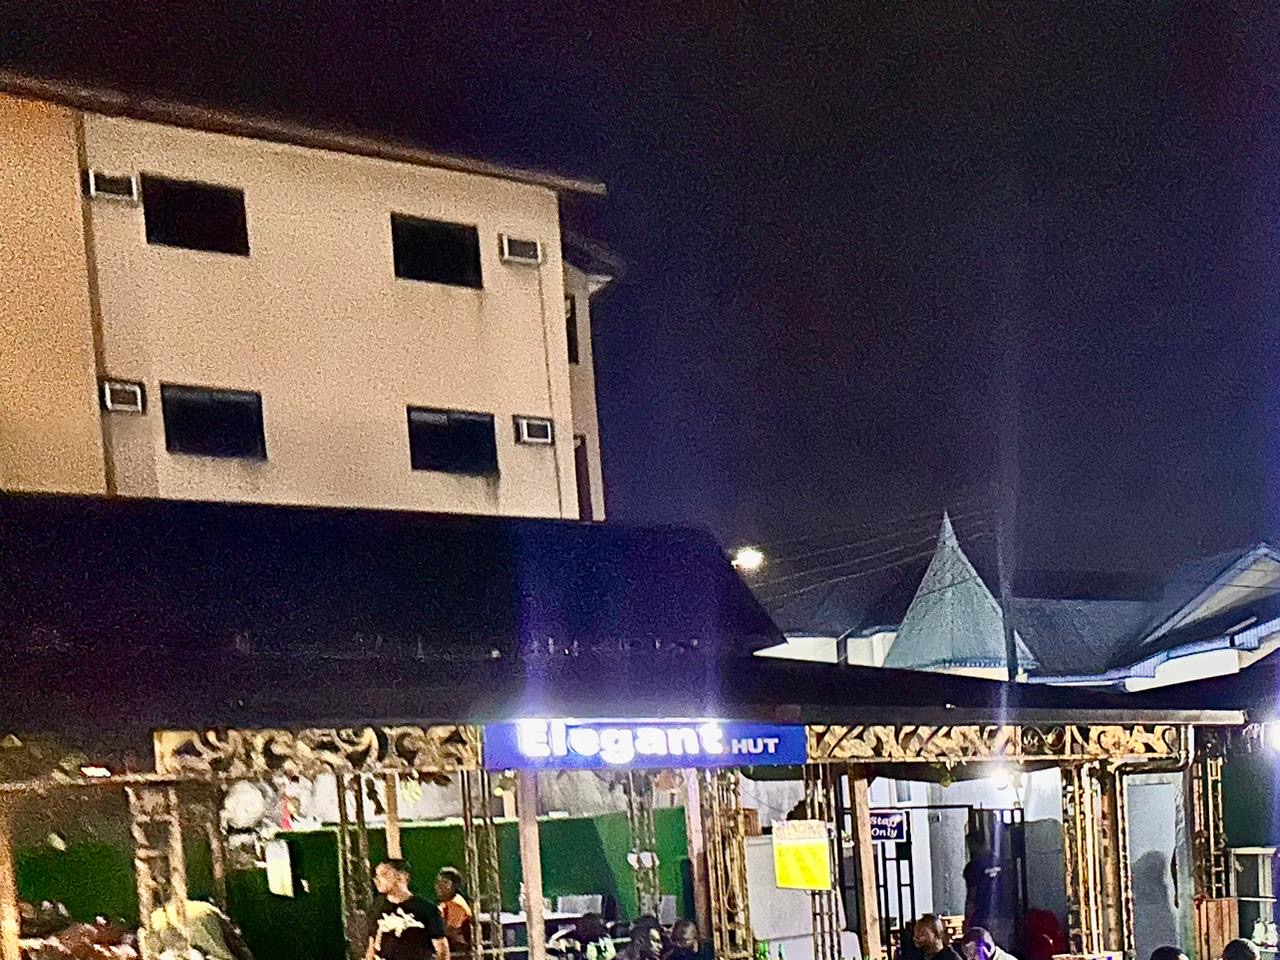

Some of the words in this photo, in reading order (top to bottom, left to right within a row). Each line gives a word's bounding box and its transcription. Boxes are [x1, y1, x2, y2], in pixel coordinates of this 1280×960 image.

[518, 718, 723, 764] Elegant
[731, 737, 779, 754] HUT
[871, 828, 898, 838] Only
